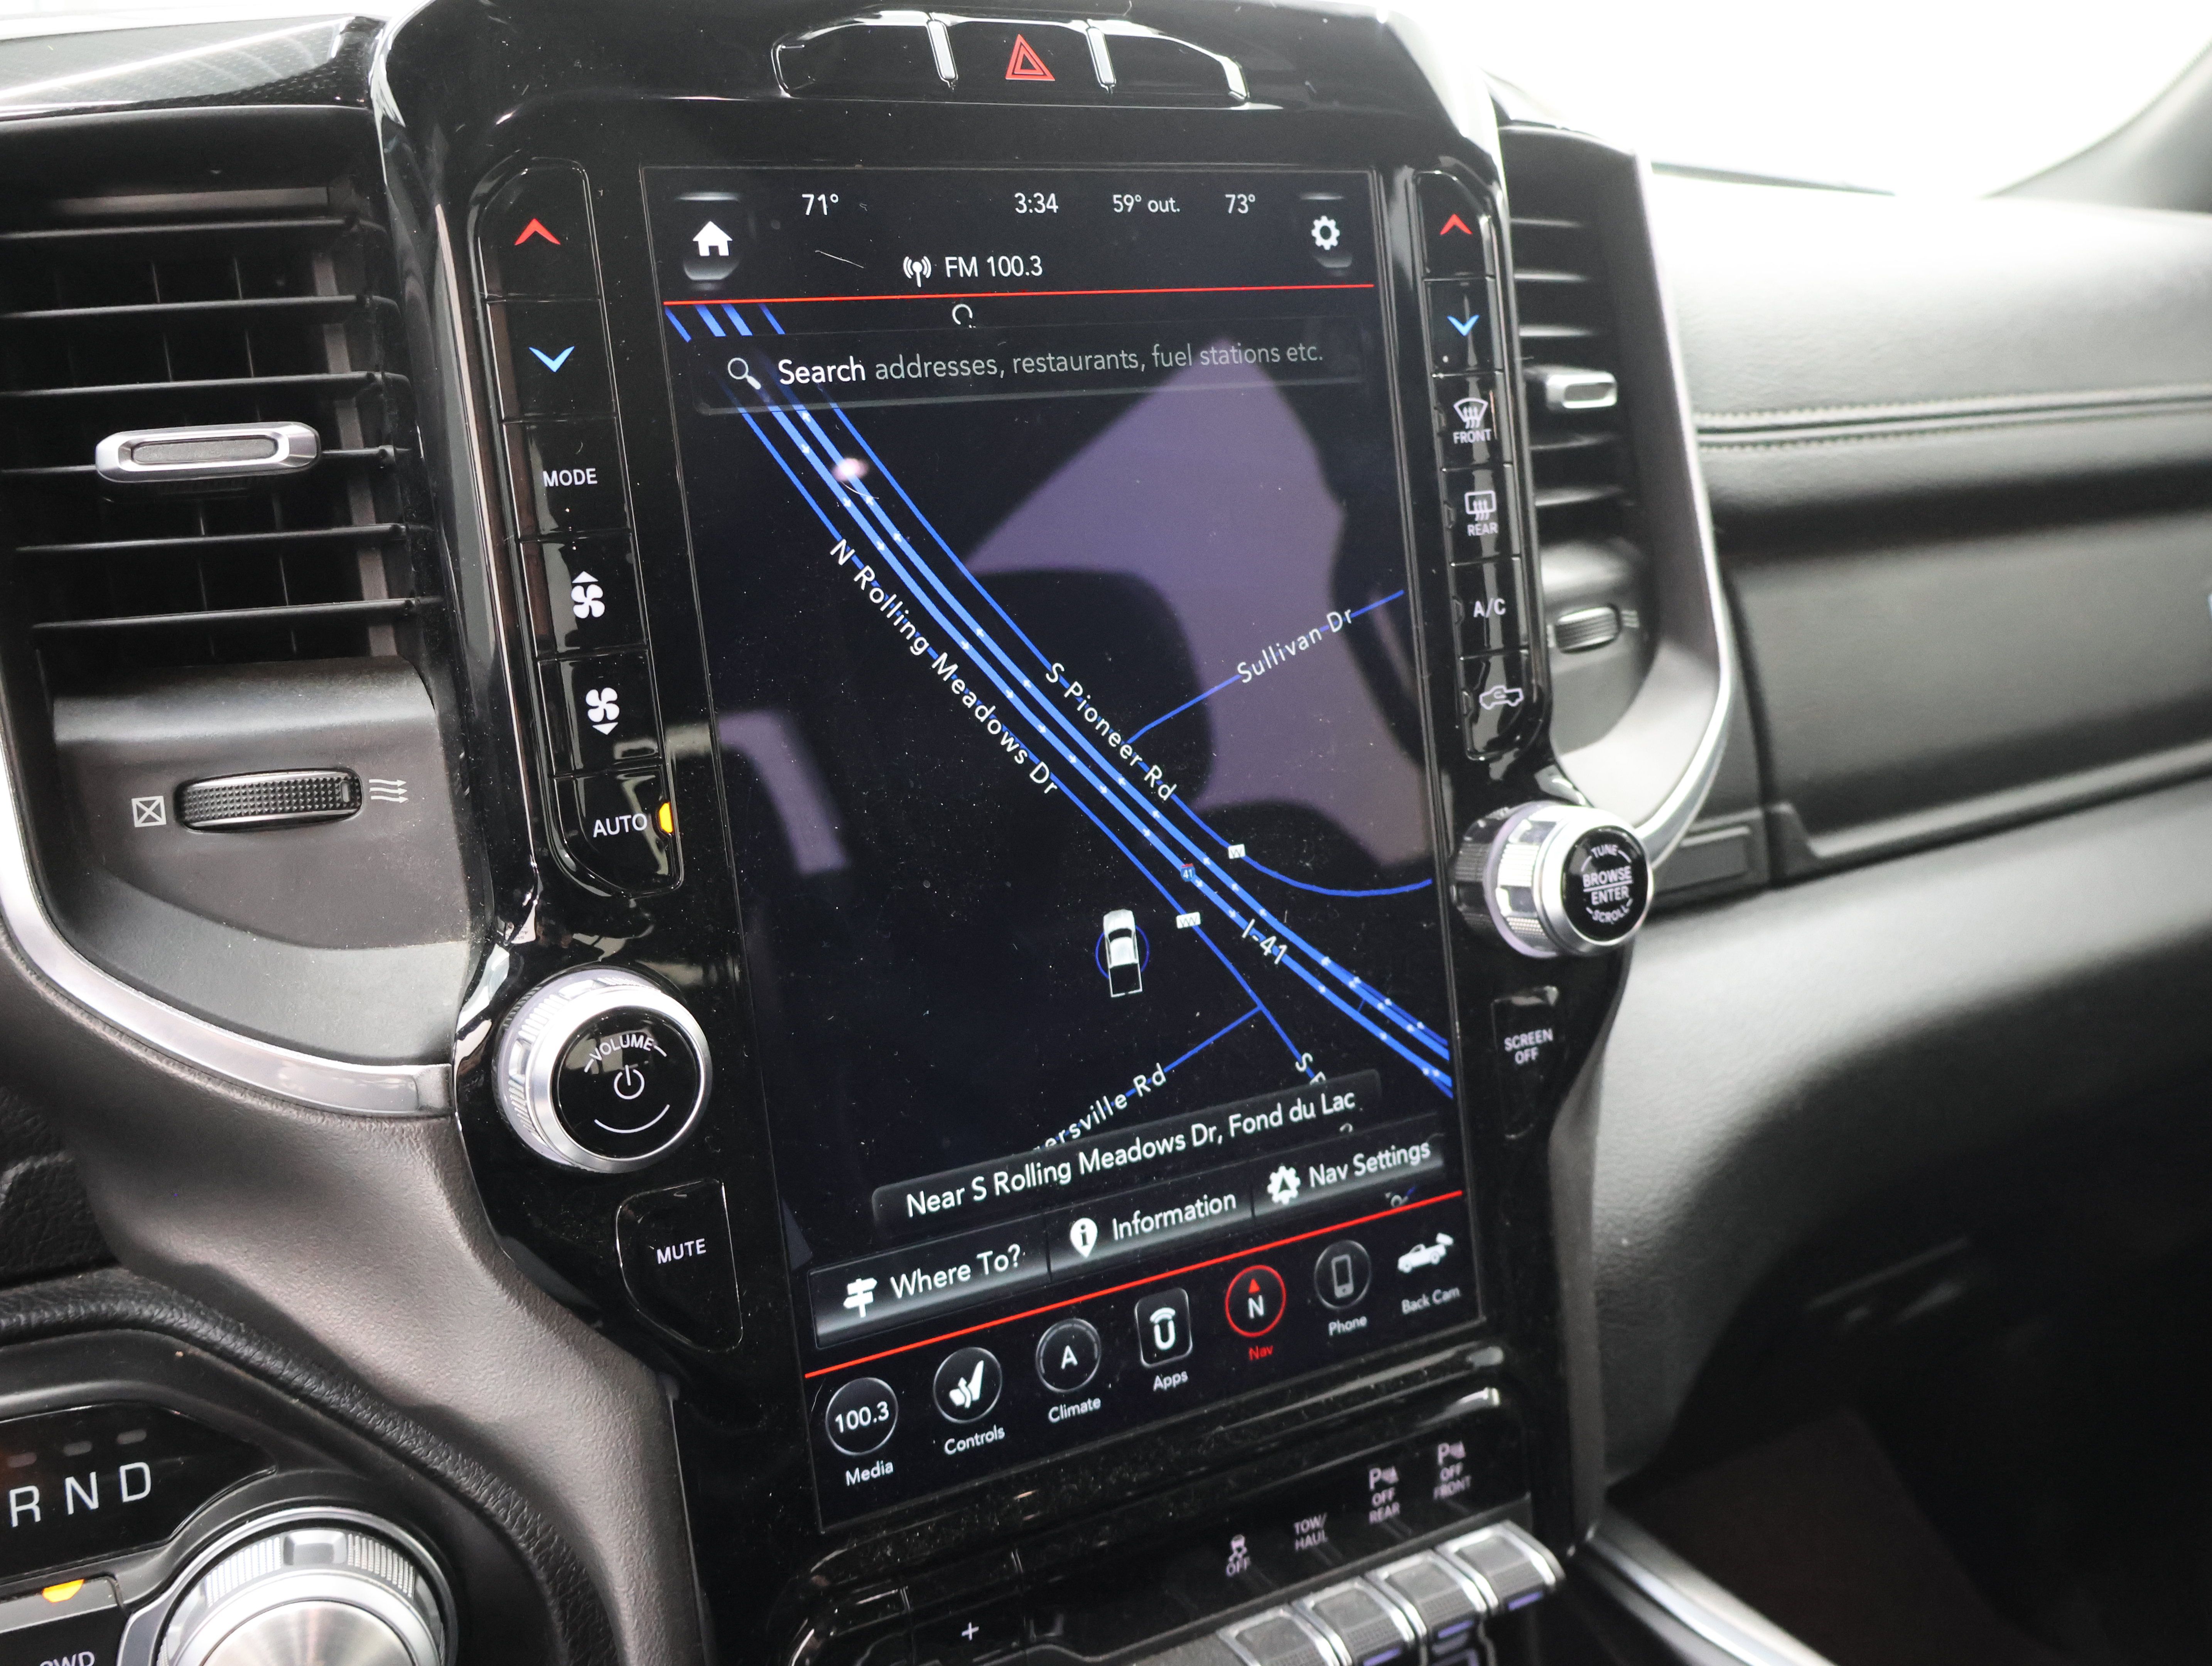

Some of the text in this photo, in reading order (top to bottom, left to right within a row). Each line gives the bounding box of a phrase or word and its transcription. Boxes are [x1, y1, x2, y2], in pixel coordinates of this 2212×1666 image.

[802, 194, 839, 216] 71°
[1014, 192, 1059, 213] 3:34
[1113, 194, 1180, 213] 59° out.
[1225, 194, 1255, 214] 73°
[945, 255, 1043, 278] FM 100.3
[778, 342, 1323, 385] Search addresses, restaurants, fuel stations etc.
[1453, 428, 1492, 444] FRONT
[543, 468, 597, 487] MODE
[1467, 523, 1498, 537] REAR
[1473, 598, 1506, 617] A/C
[1237, 609, 1353, 683] Sullivan Dr
[830, 539, 1058, 794] N Rolling Meadows Dr
[1045, 663, 1177, 801] S Pioneer Rd
[593, 813, 648, 837] AUTO
[1591, 844, 1619, 857] TUNE
[1183, 868, 1193, 879] 41
[1583, 867, 1632, 887] BROWSE
[1591, 886, 1629, 906] ENTER
[1591, 906, 1629, 925] SCROLL
[1242, 919, 1287, 964] I-41
[591, 1034, 655, 1062] VOLUME
[1504, 1029, 1553, 1052] SCREEN
[1295, 1052, 1313, 1072] S
[1515, 1051, 1539, 1065] OFF
[1034, 1062, 1166, 1151] ersville Rd
[906, 1092, 1355, 1217] Near S Rolling Meadows Dr, Fond du Lac
[1309, 1142, 1431, 1188] Nav Settings
[1112, 1194, 1236, 1240] Information
[657, 1238, 706, 1264] MUTE
[890, 1244, 1021, 1299] Where To?
[1248, 1295, 1264, 1319] N
[1402, 1287, 1460, 1314] Back Cam
[1328, 1316, 1367, 1336] Phone
[1061, 1345, 1078, 1369] A
[1249, 1346, 1273, 1360] Nav
[1153, 1371, 1188, 1391] Apps
[835, 1401, 889, 1433] 100.3
[1048, 1398, 1101, 1422] Climate
[944, 1424, 1005, 1455] Controls
[845, 1460, 893, 1486] Media
[1440, 1465, 1463, 1482] OFF
[9, 1462, 151, 1527] R N D
[1372, 1489, 1395, 1507] OFF
[1433, 1476, 1471, 1499] FRONT
[1369, 1502, 1400, 1523] REAR
[1294, 1514, 1327, 1535] TOW/
[1295, 1532, 1328, 1551] HAUL
[1226, 1558, 1250, 1577] OFF
